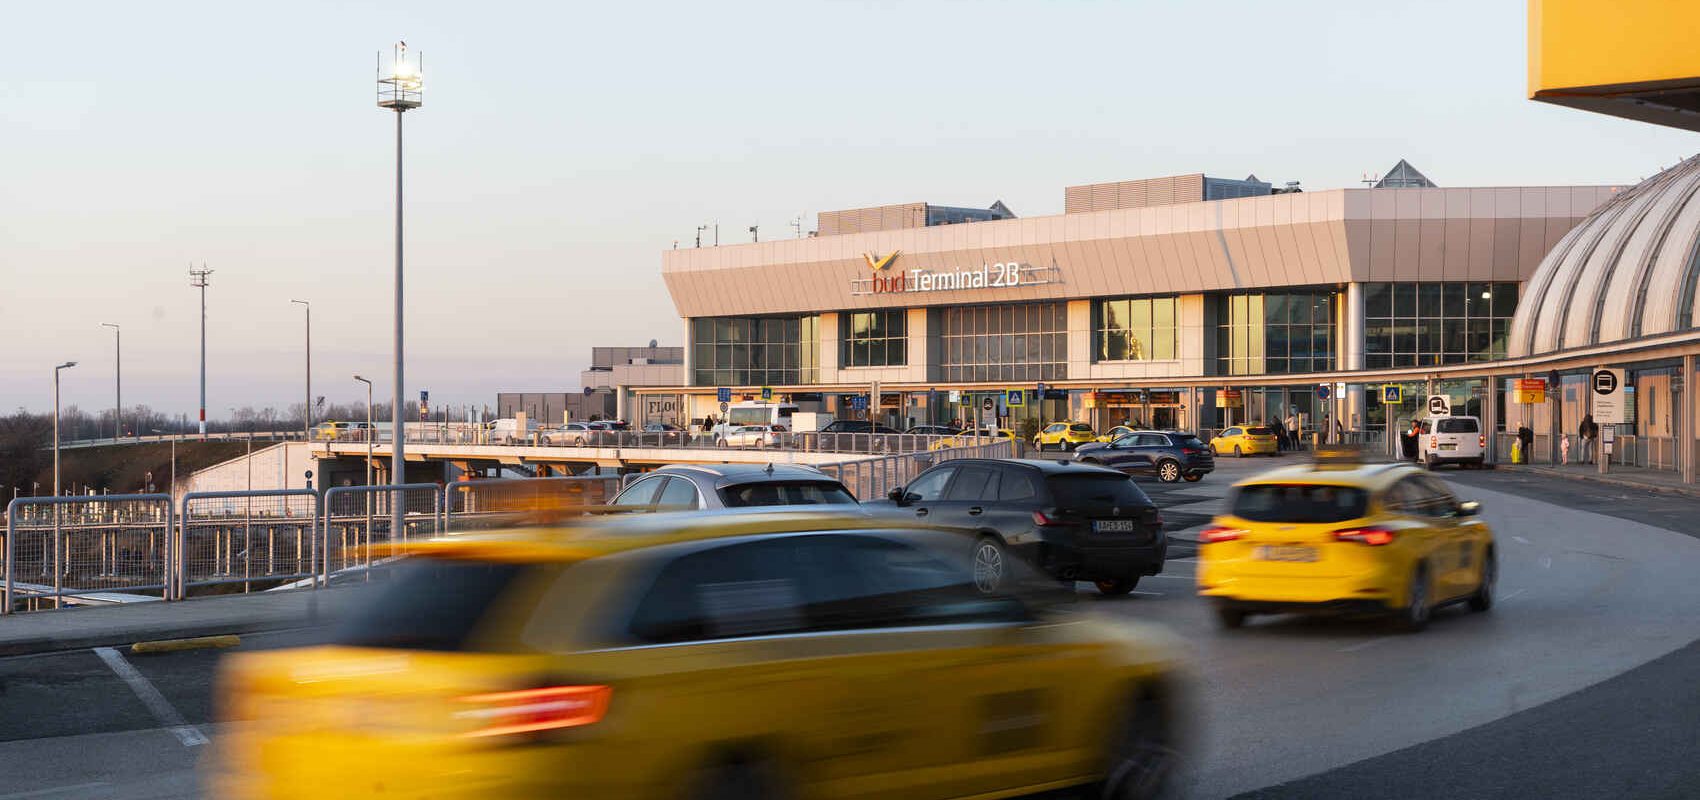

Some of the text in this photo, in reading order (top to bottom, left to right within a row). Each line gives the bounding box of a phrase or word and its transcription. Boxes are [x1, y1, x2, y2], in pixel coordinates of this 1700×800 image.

[872, 262, 1020, 294] bud Terminal 2B
